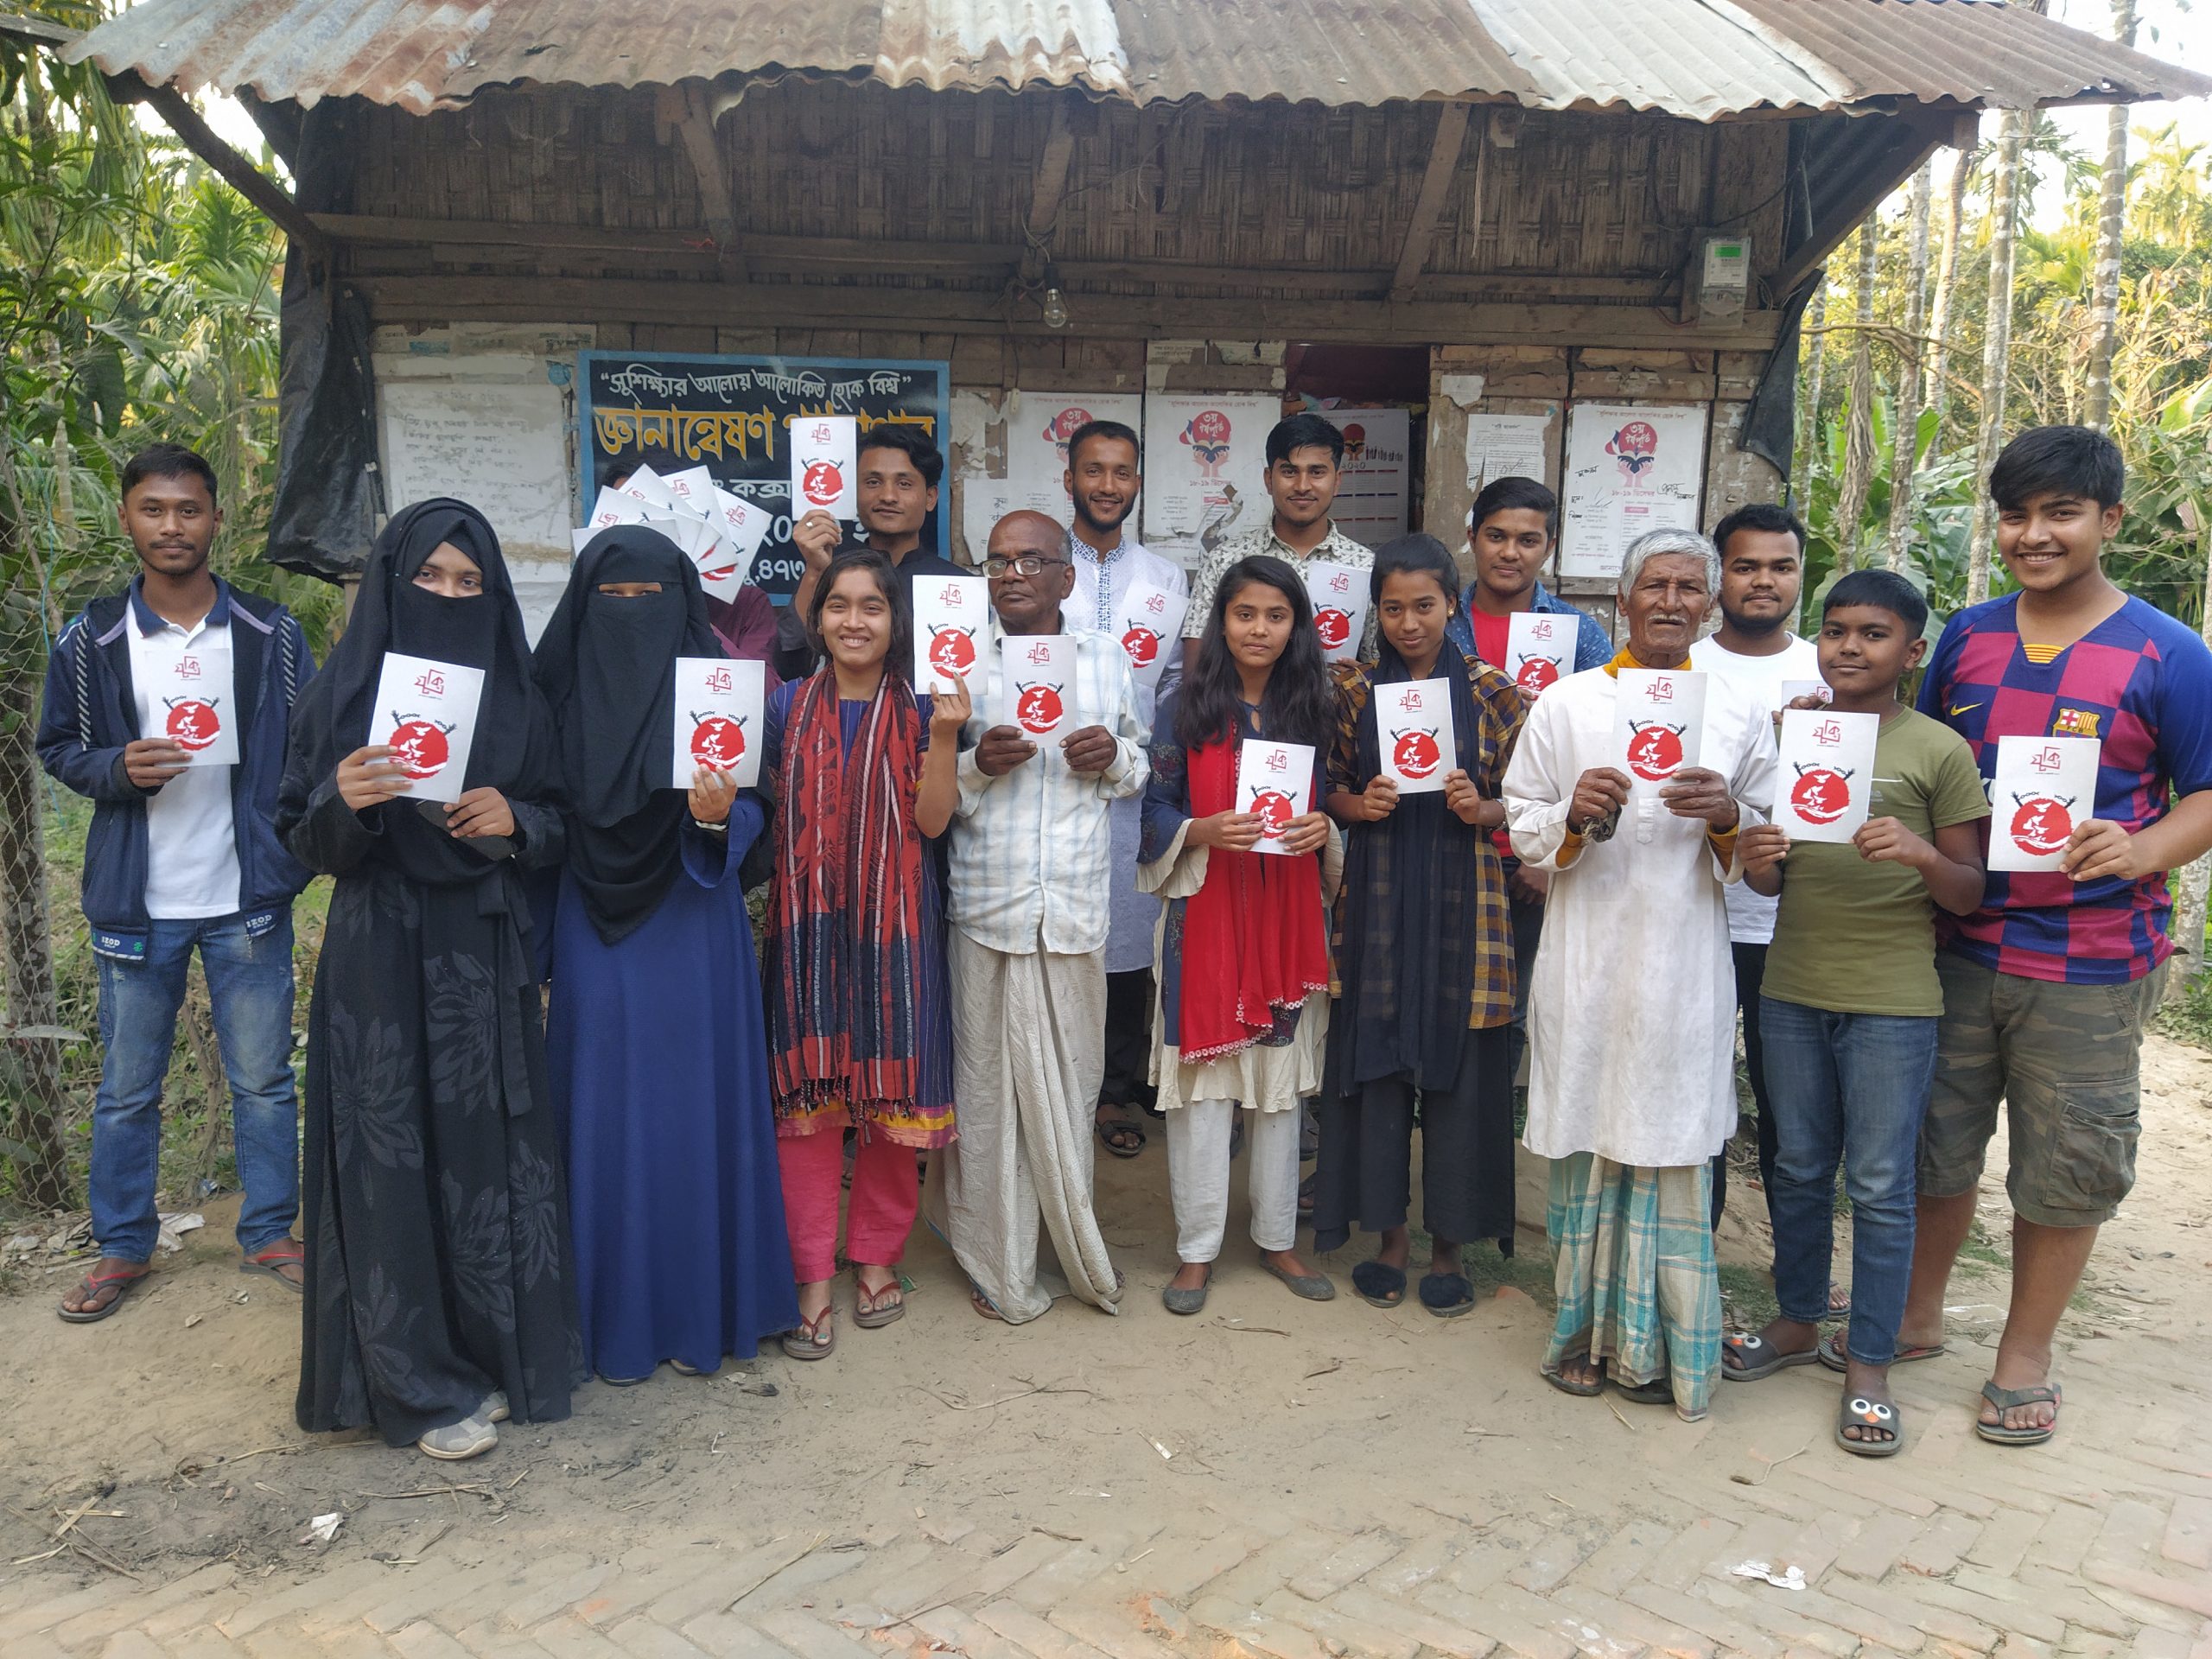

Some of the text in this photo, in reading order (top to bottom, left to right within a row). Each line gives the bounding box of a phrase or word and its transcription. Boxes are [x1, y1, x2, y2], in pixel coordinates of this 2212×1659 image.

[687, 372, 752, 404] আলোয়
[752, 369, 826, 404] আলোকিত
[831, 380, 864, 412] হোক
[1203, 413, 1217, 423] ৩য়
[593, 402, 776, 461] জ্ঞানান্বেষণ
[1630, 424, 1645, 434] ৩য়
[246, 915, 272, 928] IZOD
[102, 936, 120, 946] IZOD
